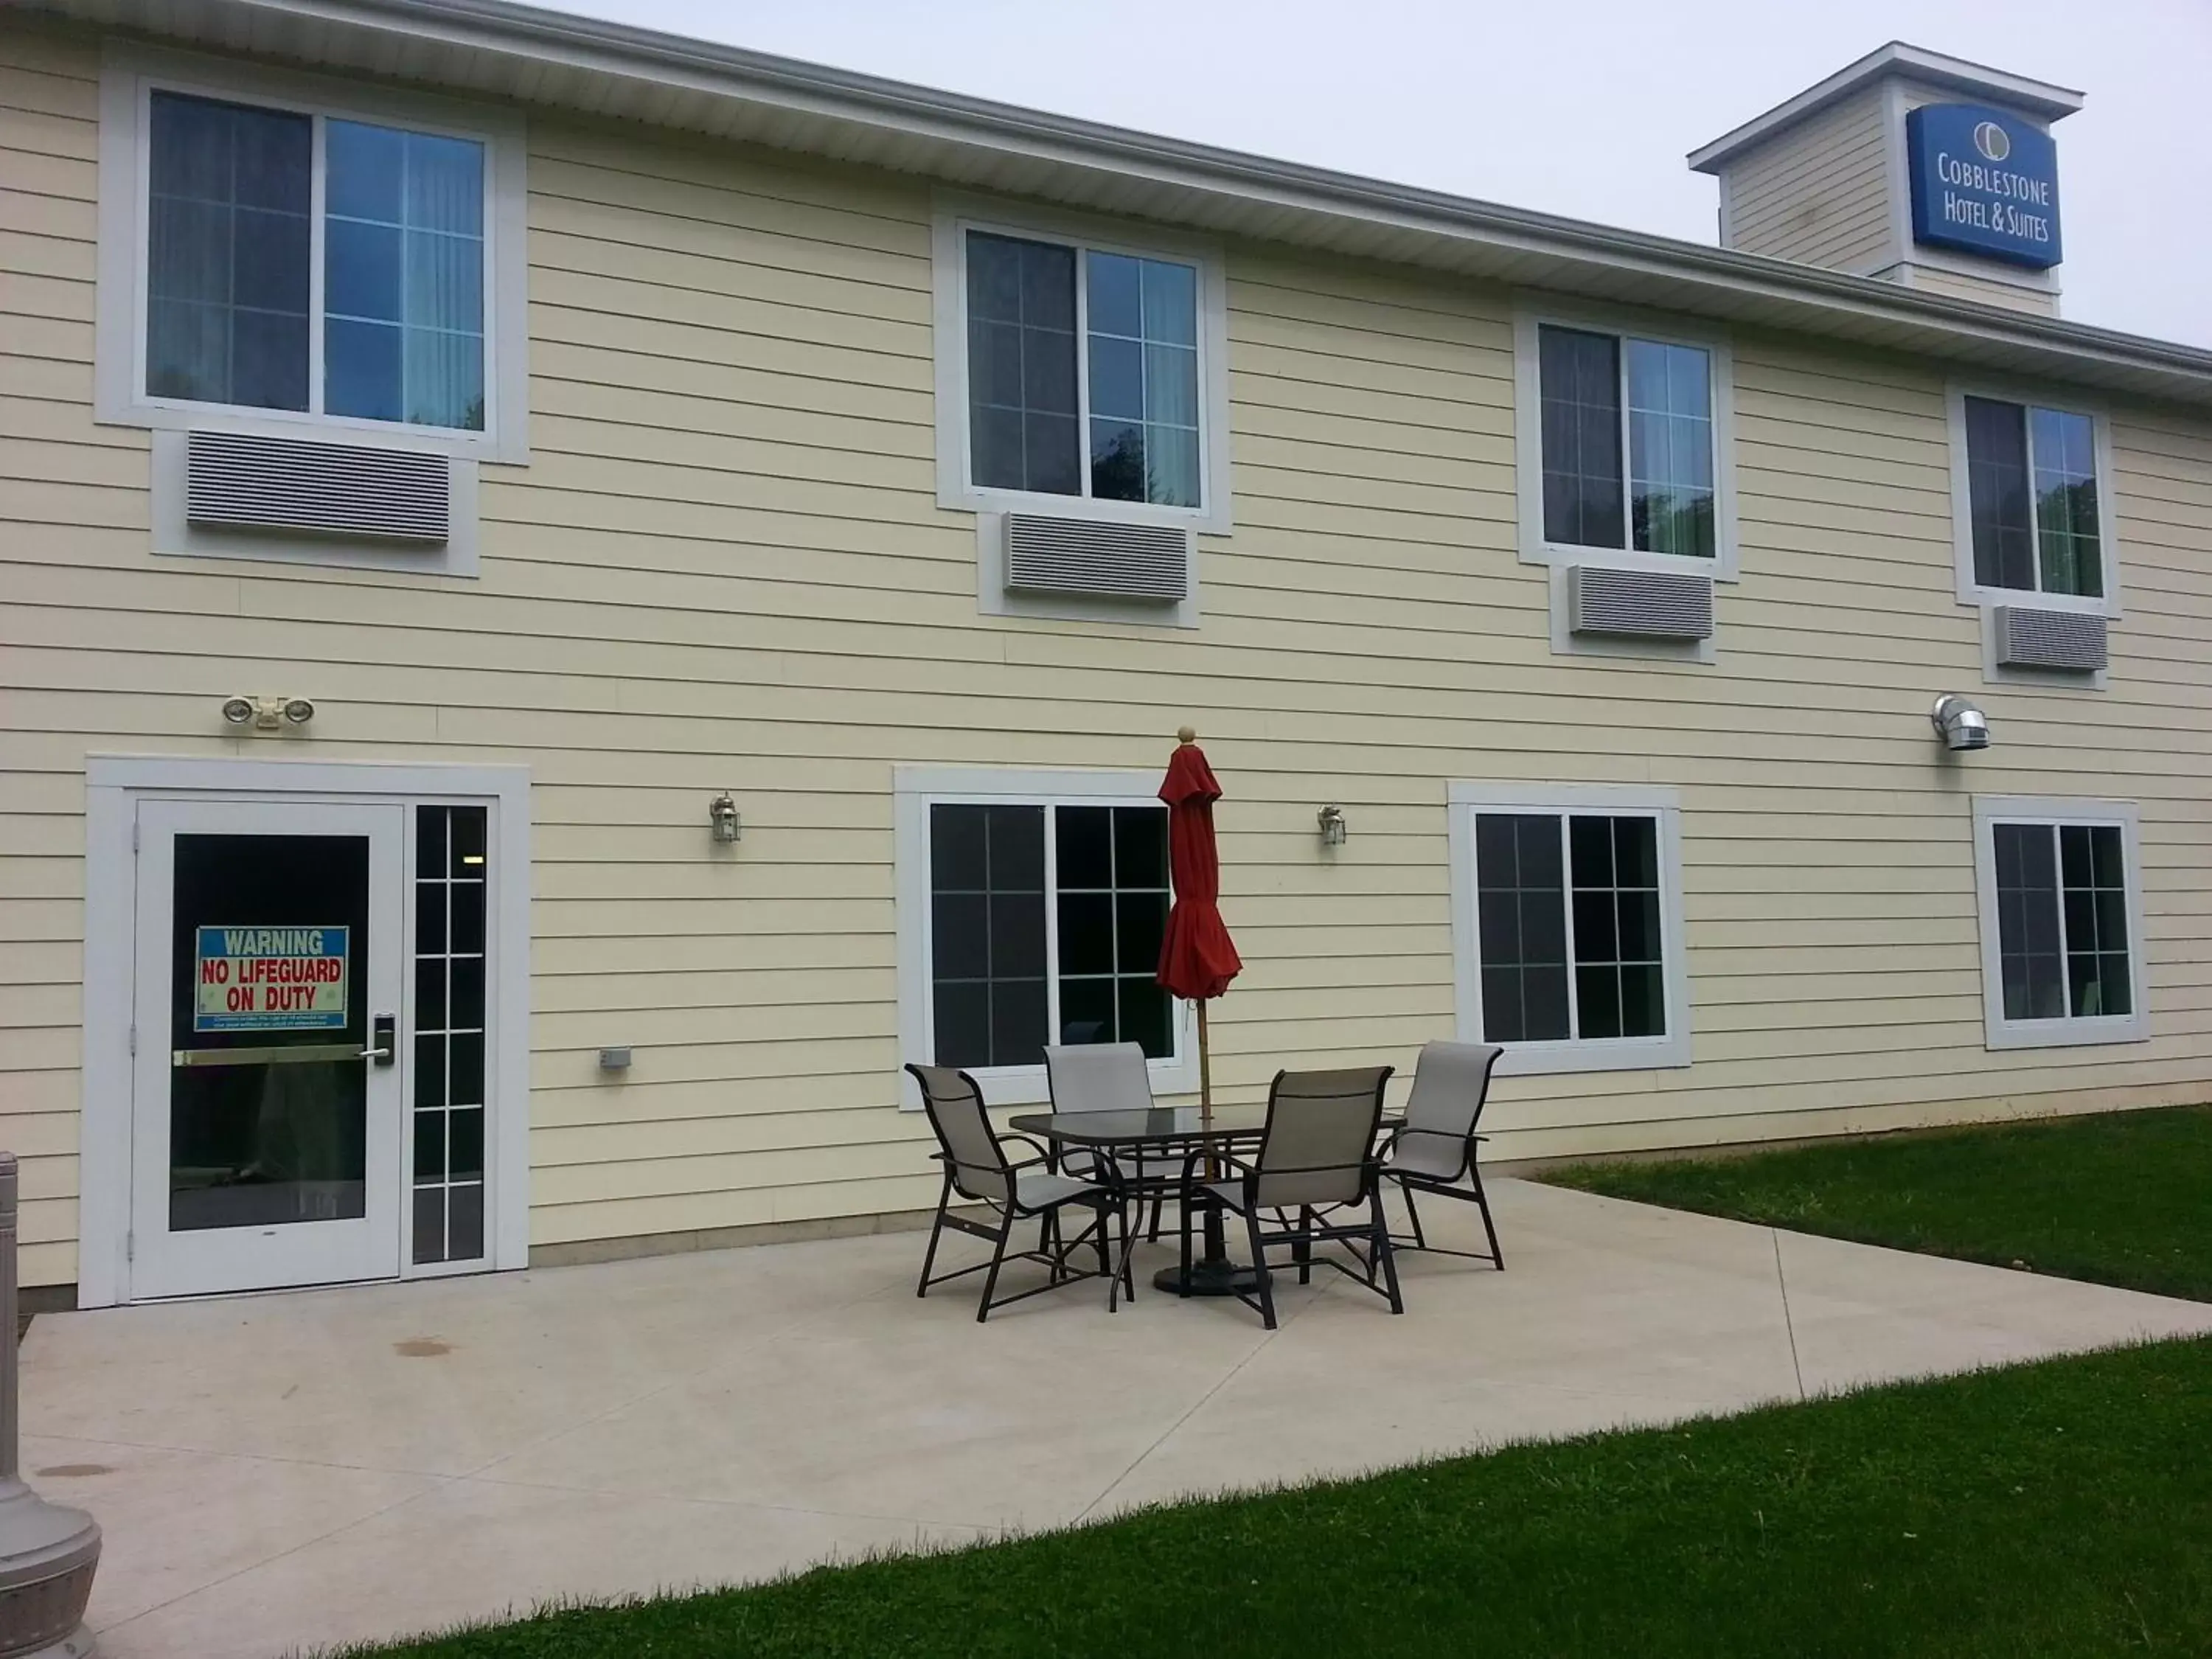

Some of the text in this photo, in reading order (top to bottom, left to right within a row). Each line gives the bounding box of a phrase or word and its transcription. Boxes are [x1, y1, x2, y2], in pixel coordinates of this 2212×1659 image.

[1938, 152, 2049, 206] COBBLESTONE
[1944, 190, 2048, 242] HOTEL & SUITES
[224, 930, 324, 956] WARNING
[202, 959, 341, 984] NO LIFEGUARD
[227, 986, 316, 1012] ON DUTY
